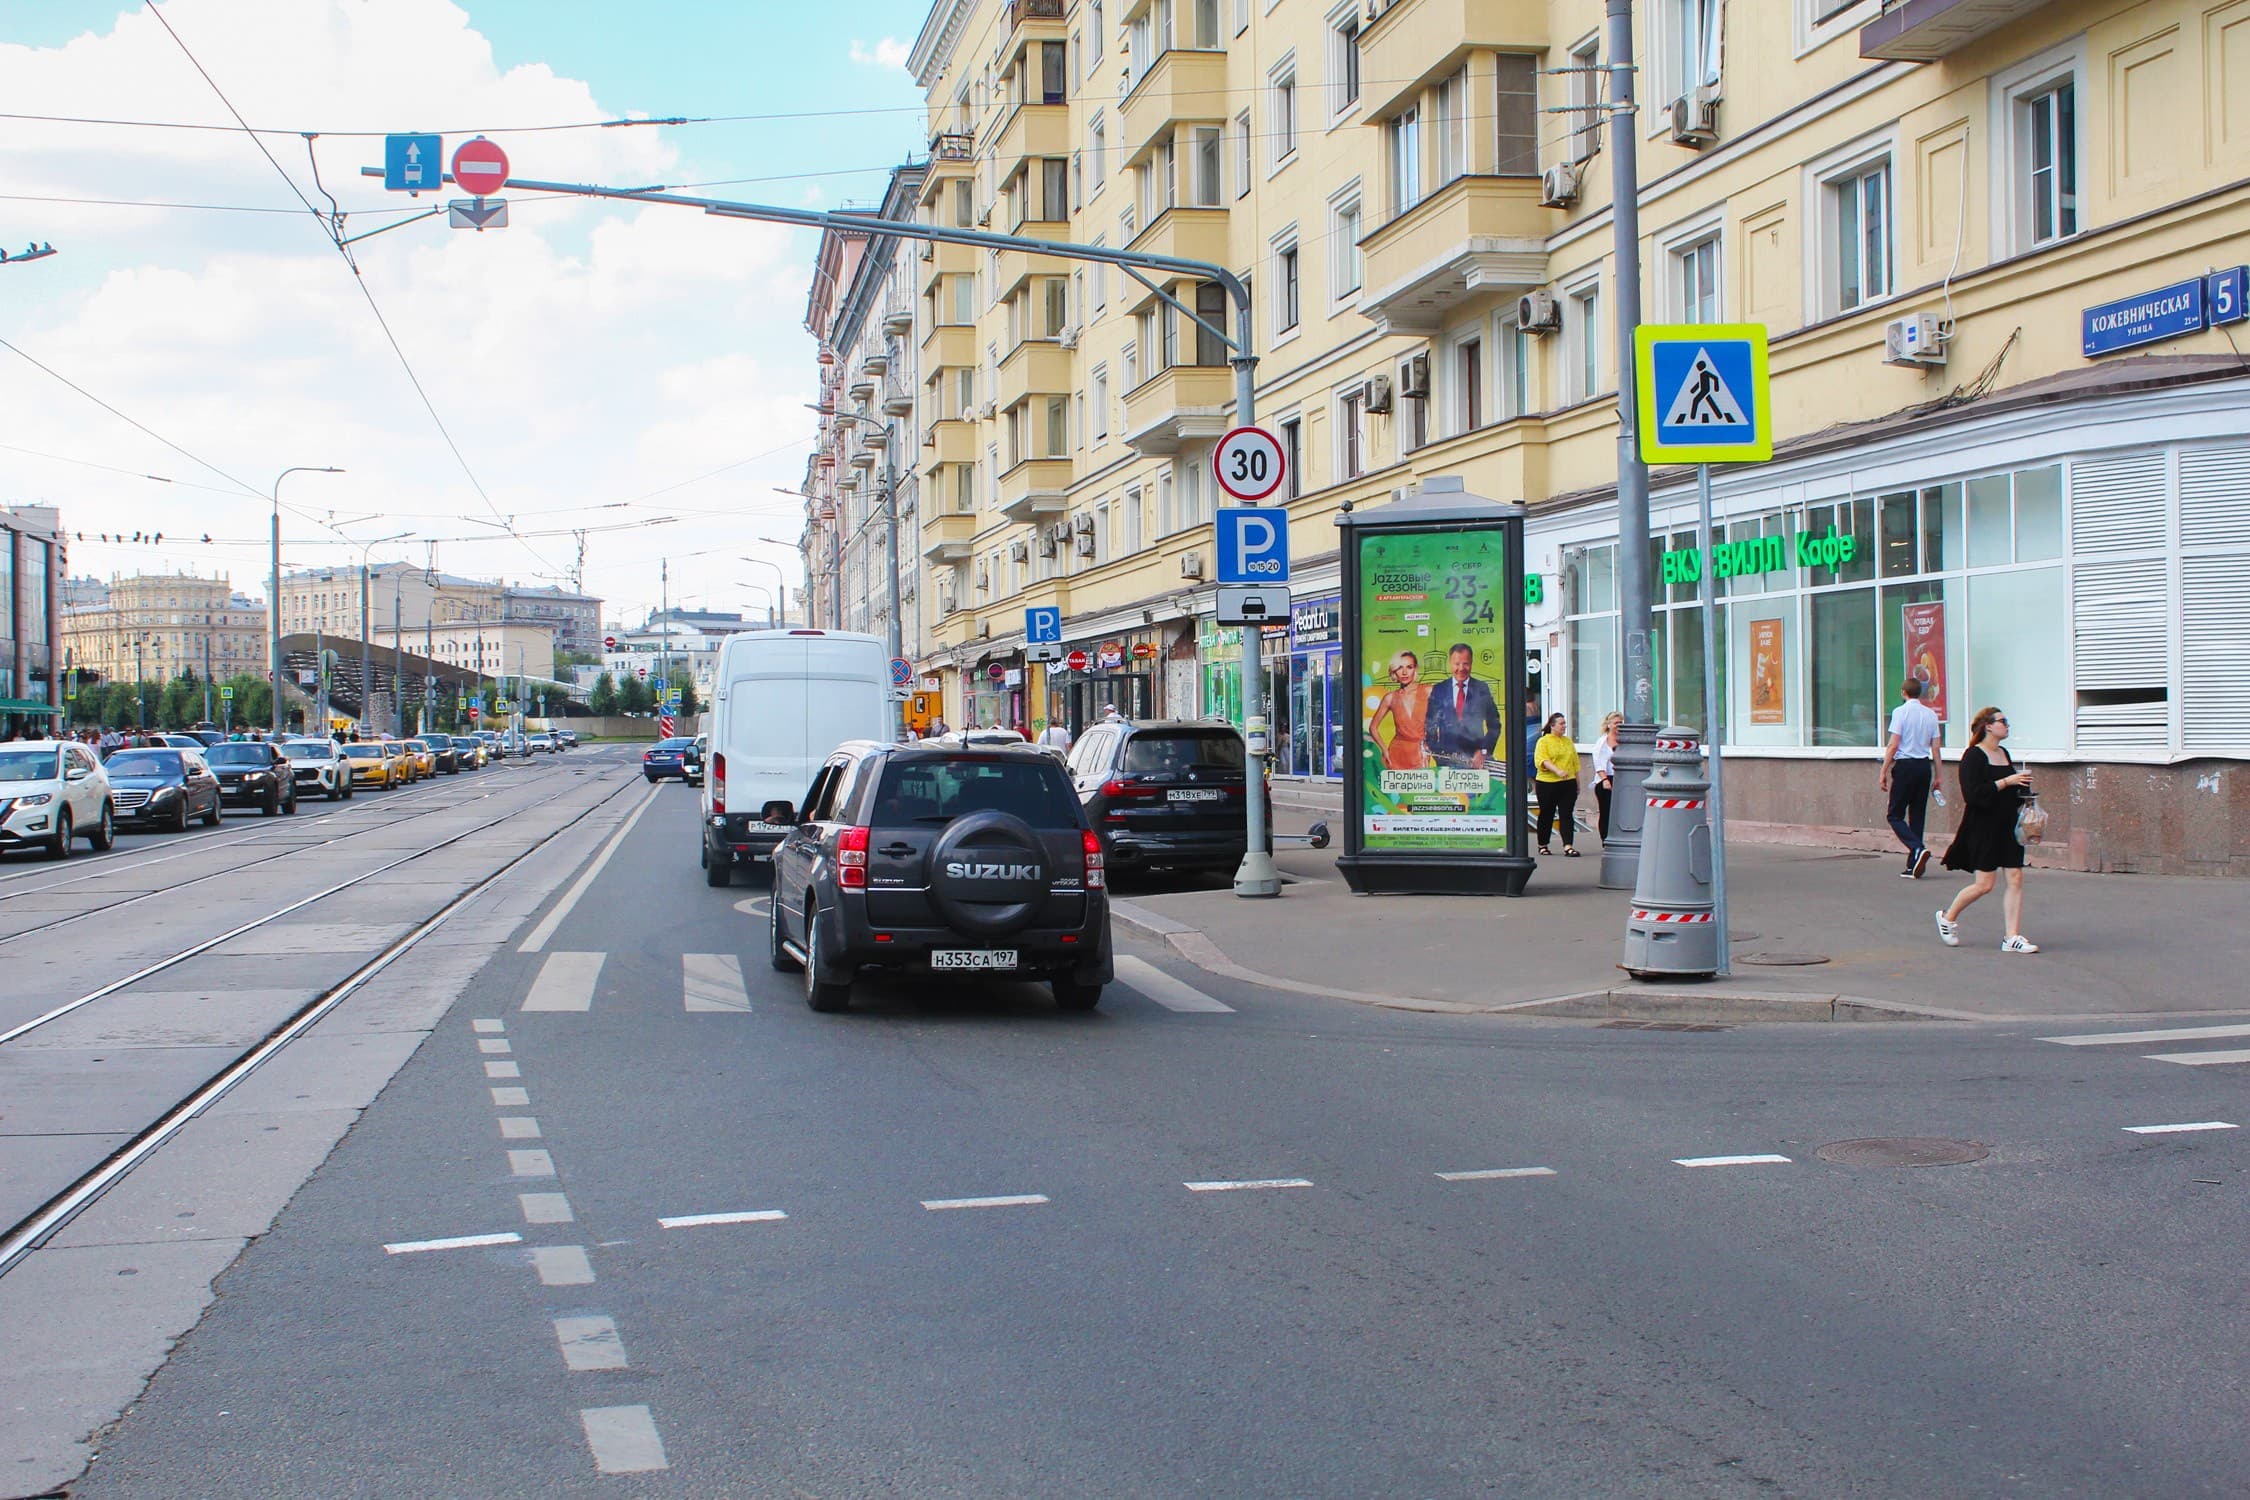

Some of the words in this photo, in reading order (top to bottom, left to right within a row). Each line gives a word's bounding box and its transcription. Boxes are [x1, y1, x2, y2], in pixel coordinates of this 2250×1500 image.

[2217, 278, 2233, 314] 5
[2092, 293, 2190, 333] КОЖЕВНИЧЕСКАЯ
[2127, 323, 2153, 337] УЛИЦА
[1231, 449, 1267, 481] 30
[1236, 516, 1276, 575] P
[1663, 535, 1786, 584] ВКУВИЛЛ
[1795, 524, 1856, 574] Кафе
[1257, 562, 1266, 571] 15
[1267, 561, 1279, 571] 20
[1373, 572, 1431, 585] Jazzовые
[1381, 582, 1427, 592] сезоны
[1294, 606, 1329, 631] Pedant.ru
[1463, 600, 1494, 624] 24
[1034, 611, 1054, 639] P
[1462, 627, 1494, 635] августа
[1483, 652, 1492, 661] 6+
[1387, 771, 1429, 780] Полина
[1448, 771, 1480, 782] Игорь
[1383, 781, 1433, 791] Гагарина
[1445, 781, 1483, 791] Бутман
[1168, 790, 1201, 800] М318ХЕ
[1412, 804, 1463, 813] jazzseasons.ru
[946, 863, 1041, 881] SUZUKI
[935, 952, 990, 966] Н353СА
[993, 951, 1015, 962] 197
